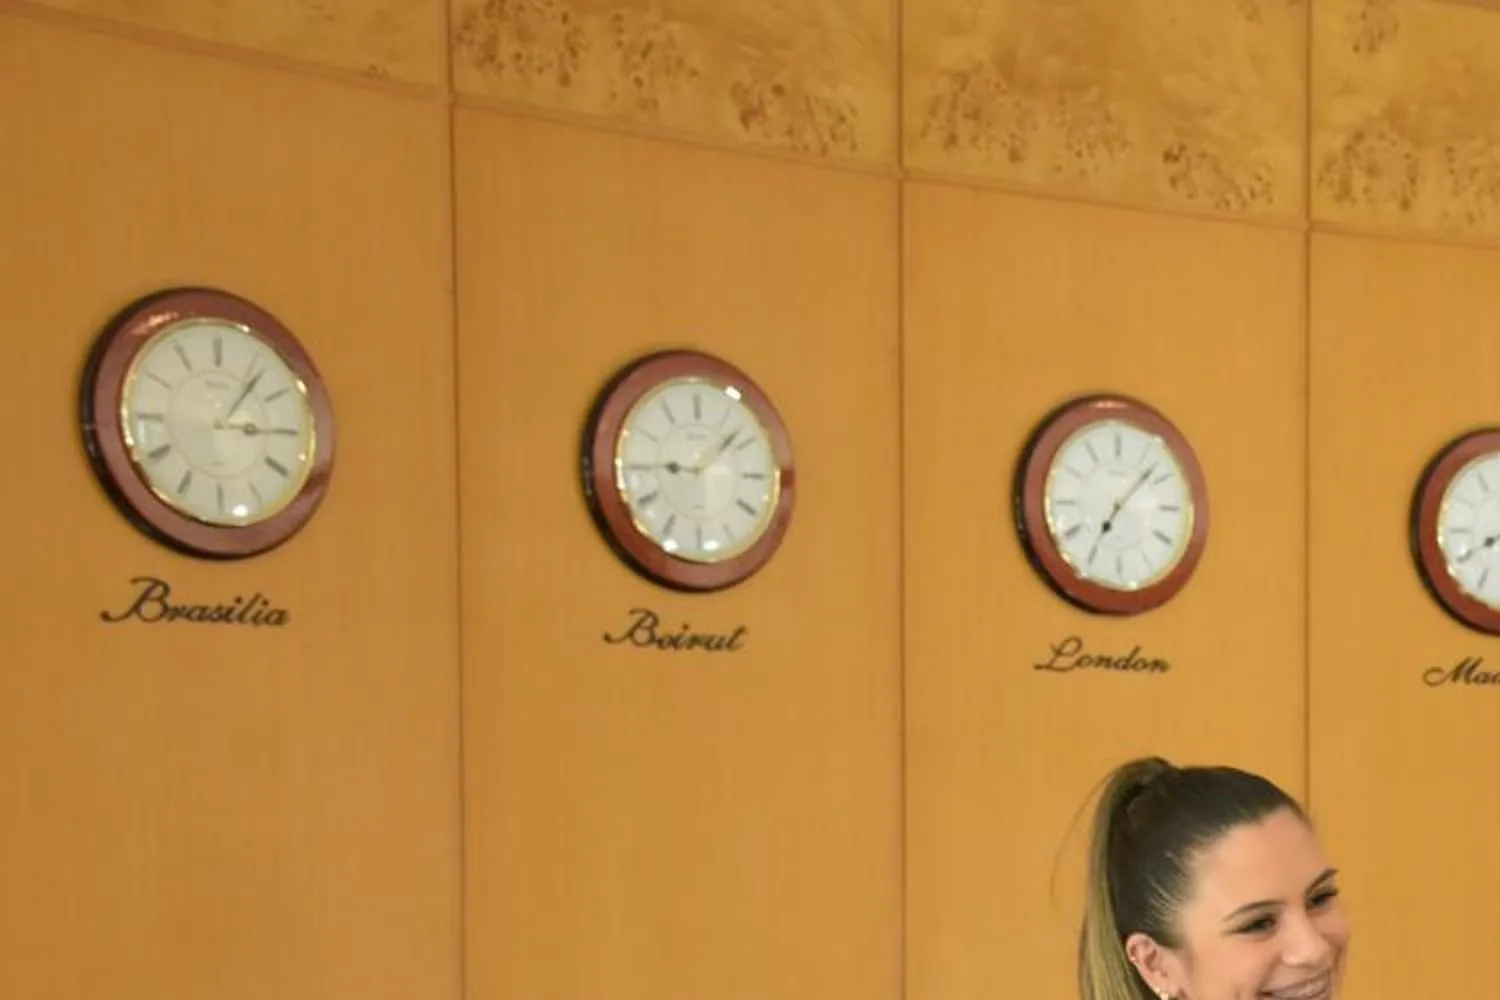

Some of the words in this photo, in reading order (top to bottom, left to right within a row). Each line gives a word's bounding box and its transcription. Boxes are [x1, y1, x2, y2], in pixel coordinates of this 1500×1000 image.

[99, 576, 288, 626] Brasilia
[603, 608, 746, 652] Beirut
[1034, 636, 1170, 673] London
